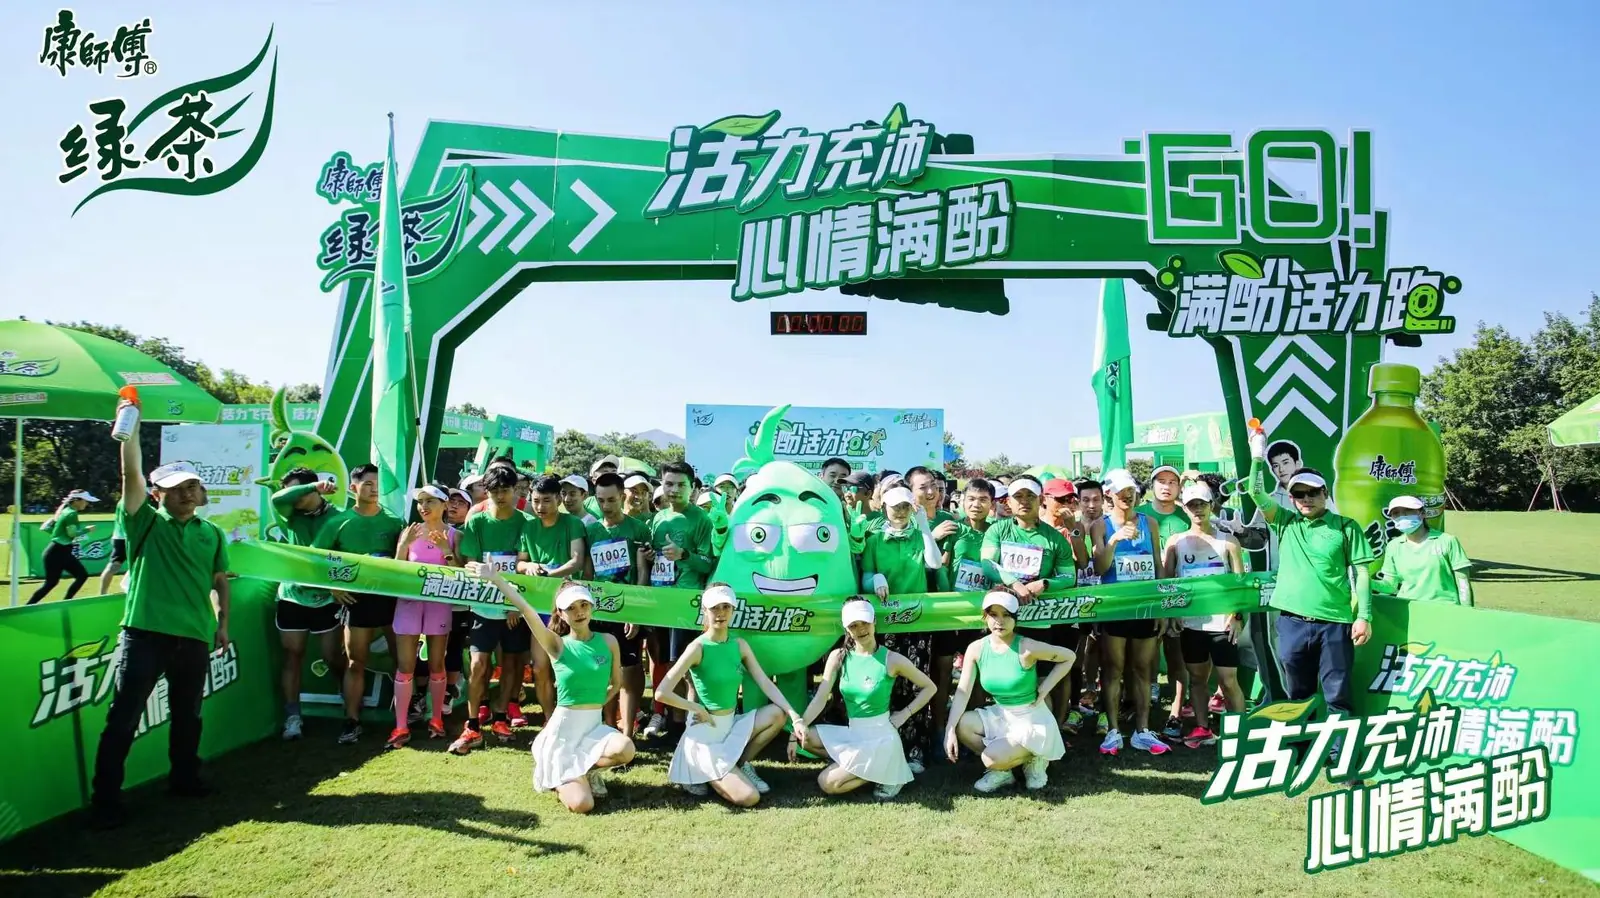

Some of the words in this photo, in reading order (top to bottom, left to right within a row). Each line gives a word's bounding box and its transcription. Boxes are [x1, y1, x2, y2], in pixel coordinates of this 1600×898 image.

[645, 112, 933, 214] 活力充沛
[1143, 127, 1376, 248] GO!
[735, 181, 1013, 299] 心情满酚
[1173, 256, 1455, 334] 满酚活力跑
[774, 422, 868, 457] 酚活力跑
[593, 547, 627, 564] 71002
[1002, 551, 1039, 568] 71012
[1118, 560, 1153, 572] 71062
[1370, 644, 1517, 700] 活力充沛
